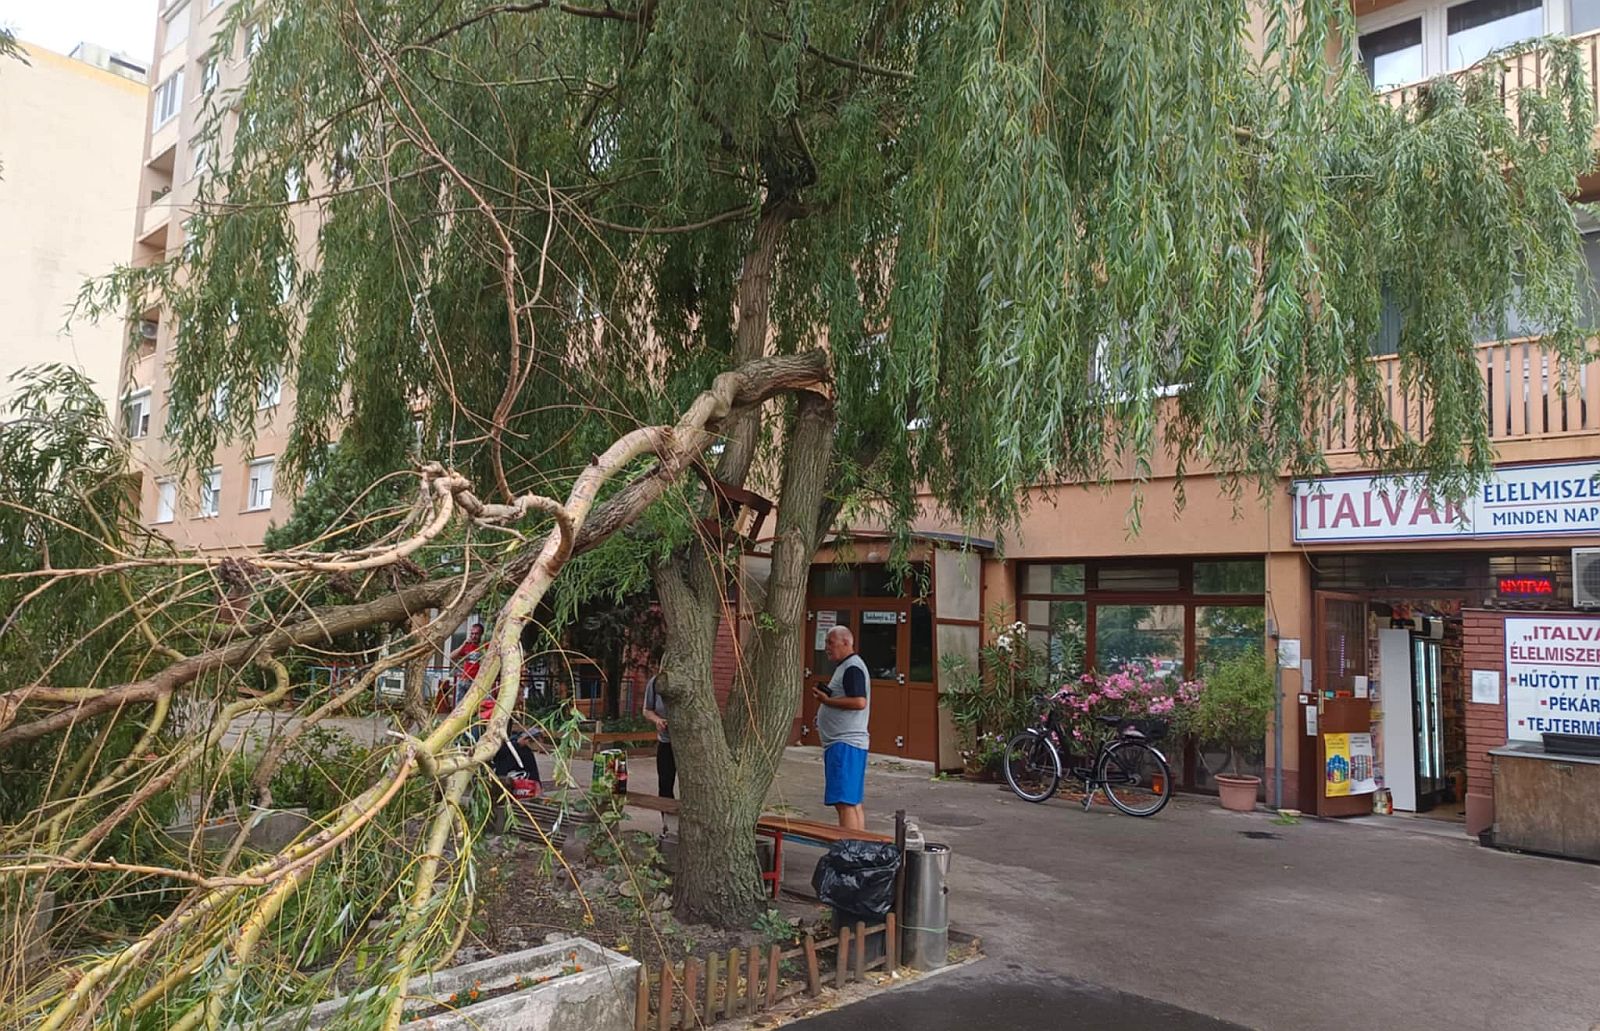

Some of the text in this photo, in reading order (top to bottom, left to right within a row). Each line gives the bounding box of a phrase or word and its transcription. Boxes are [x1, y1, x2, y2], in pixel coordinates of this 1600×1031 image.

[1493, 507, 1599, 526] MINDEN NAP
[1500, 579, 1552, 593] NYITVA
[1586, 676, 1600, 691] IT
